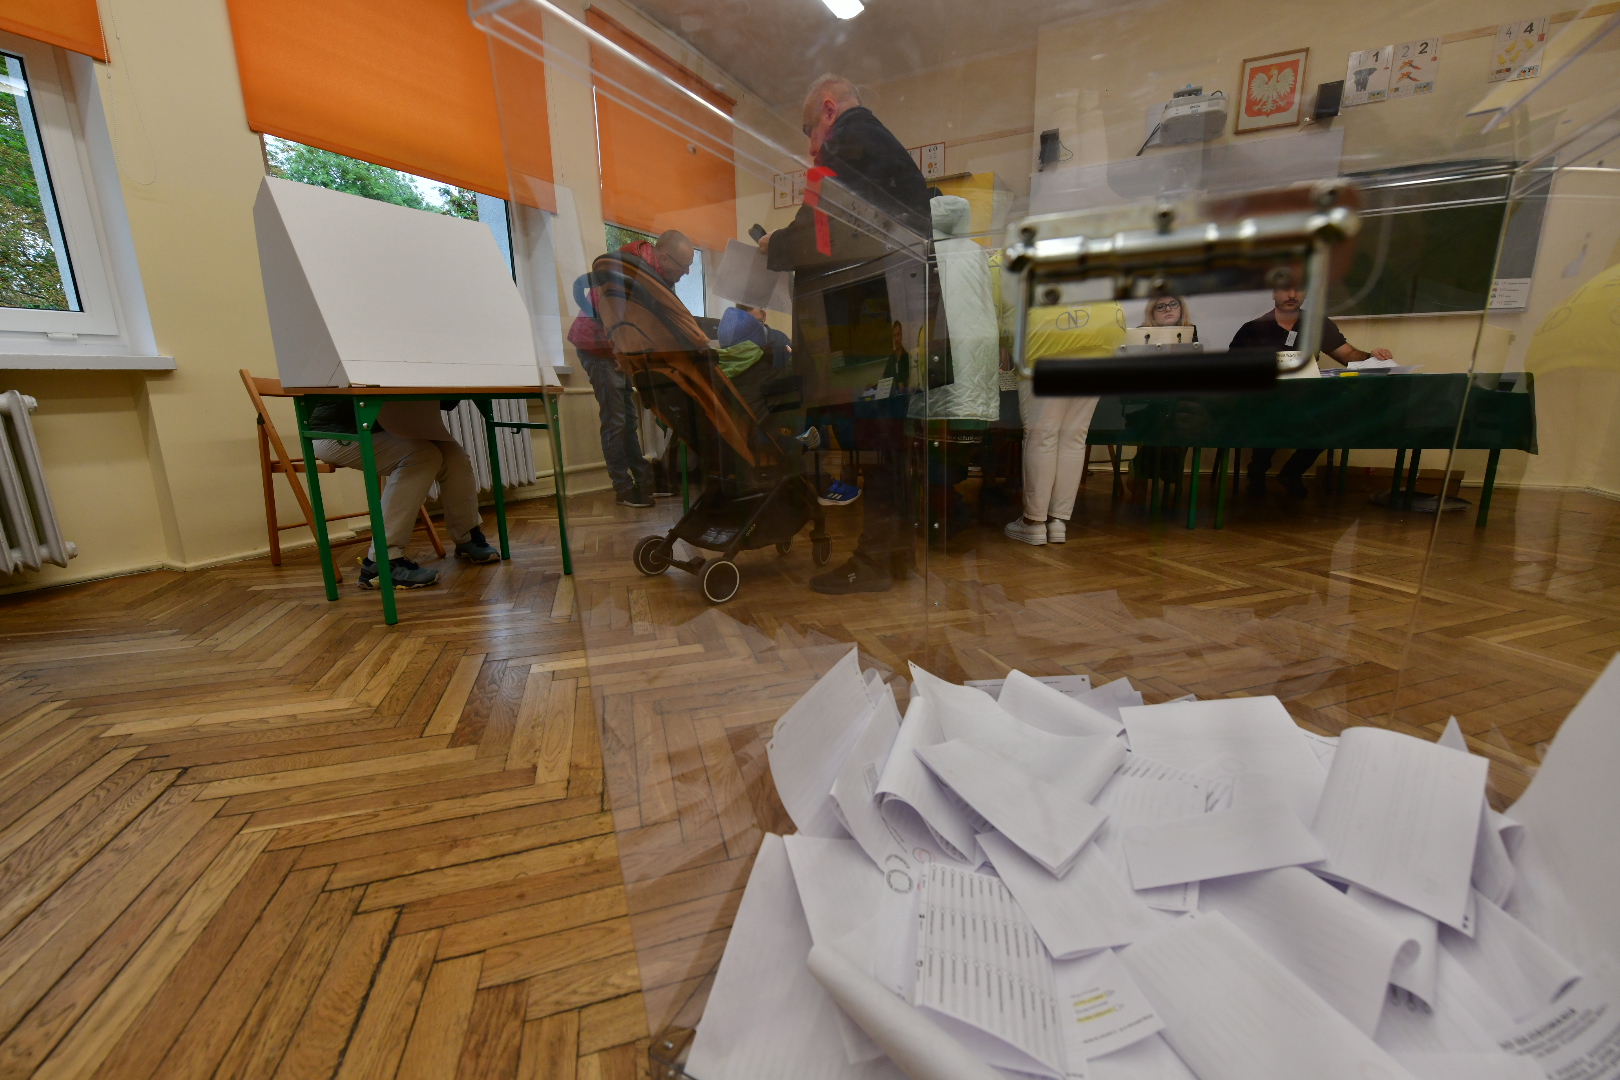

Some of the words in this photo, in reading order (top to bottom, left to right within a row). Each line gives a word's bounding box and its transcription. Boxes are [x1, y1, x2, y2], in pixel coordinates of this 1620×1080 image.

[1523, 21, 1534, 34] 4
[1401, 45, 1410, 58] 2
[1418, 41, 1429, 55] 2
[1372, 50, 1380, 63] 1
